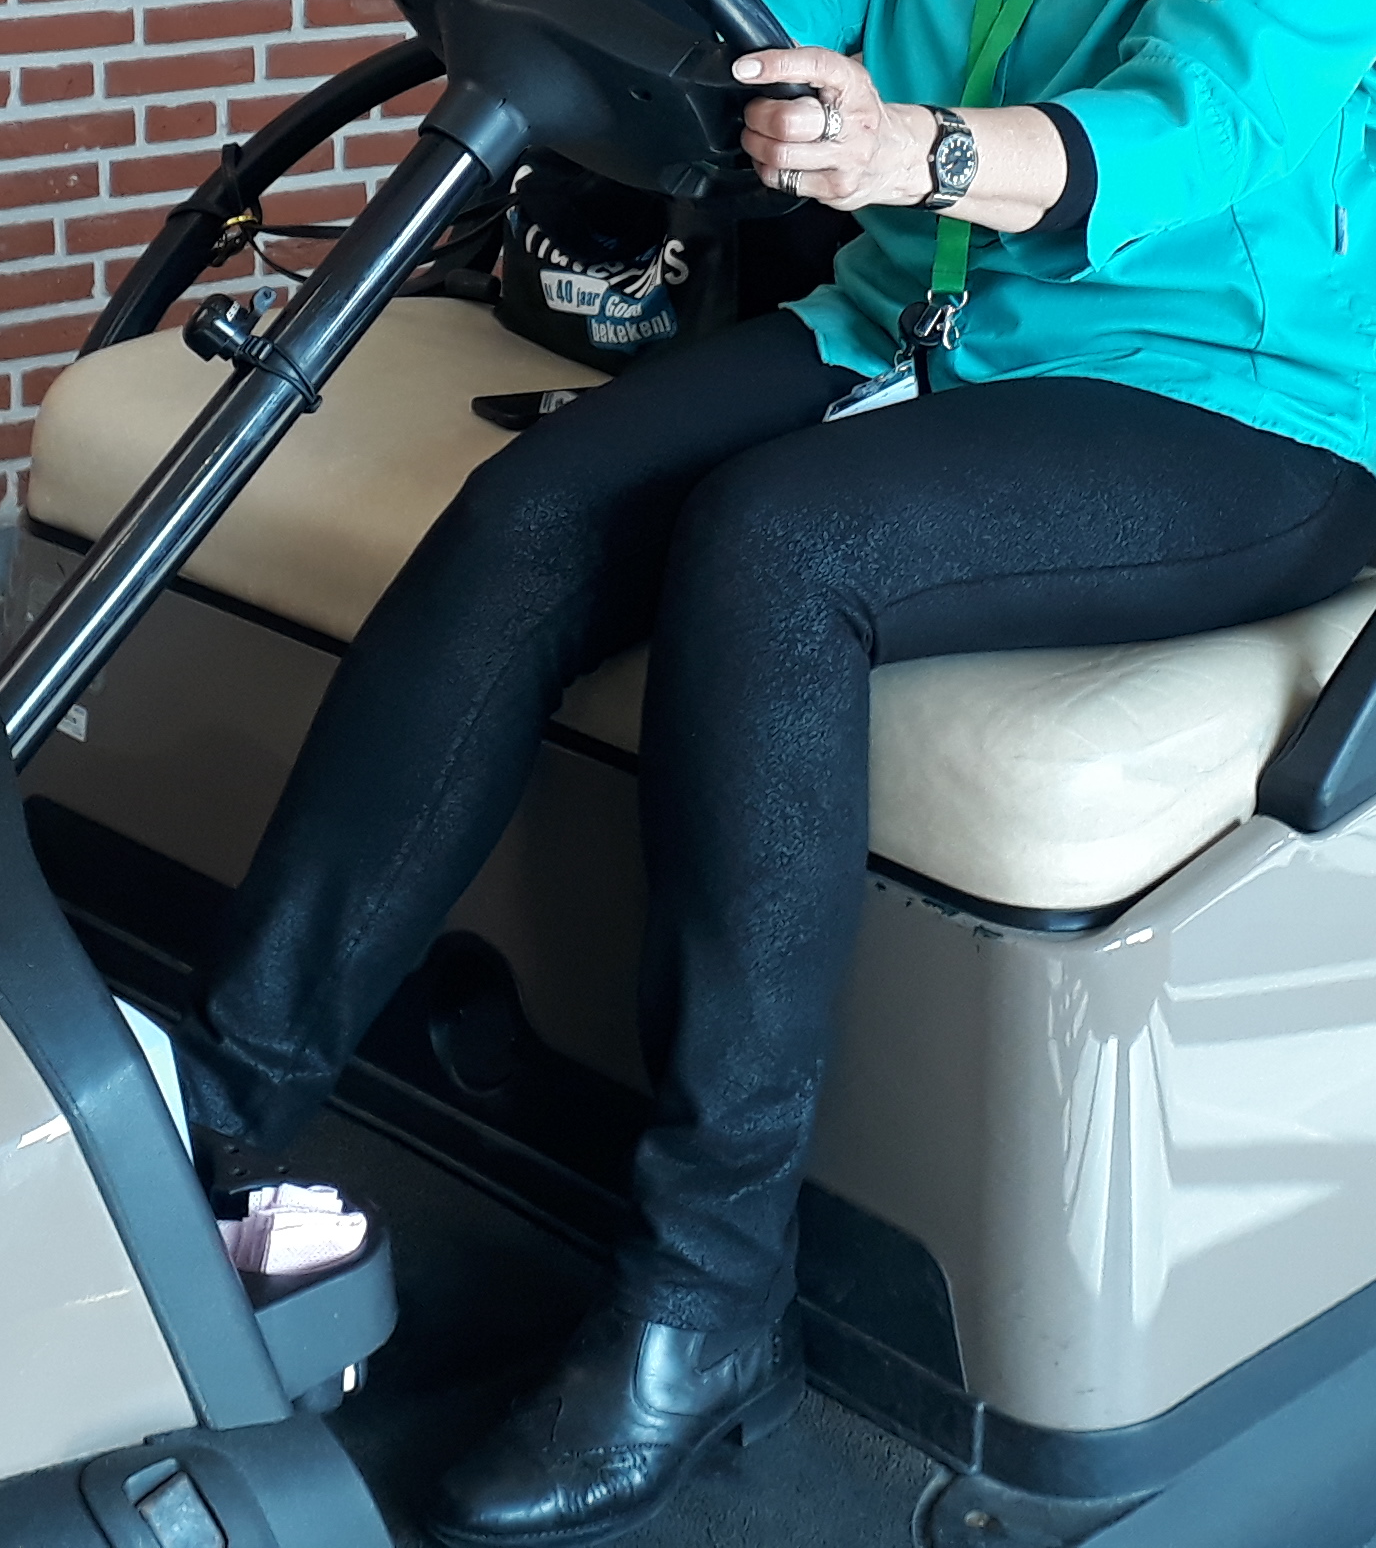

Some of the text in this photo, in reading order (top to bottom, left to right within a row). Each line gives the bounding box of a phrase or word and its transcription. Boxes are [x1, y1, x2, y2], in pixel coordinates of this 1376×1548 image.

[555, 280, 573, 304] 40
[576, 287, 600, 307] jaar
[591, 310, 672, 343] bekeken!
